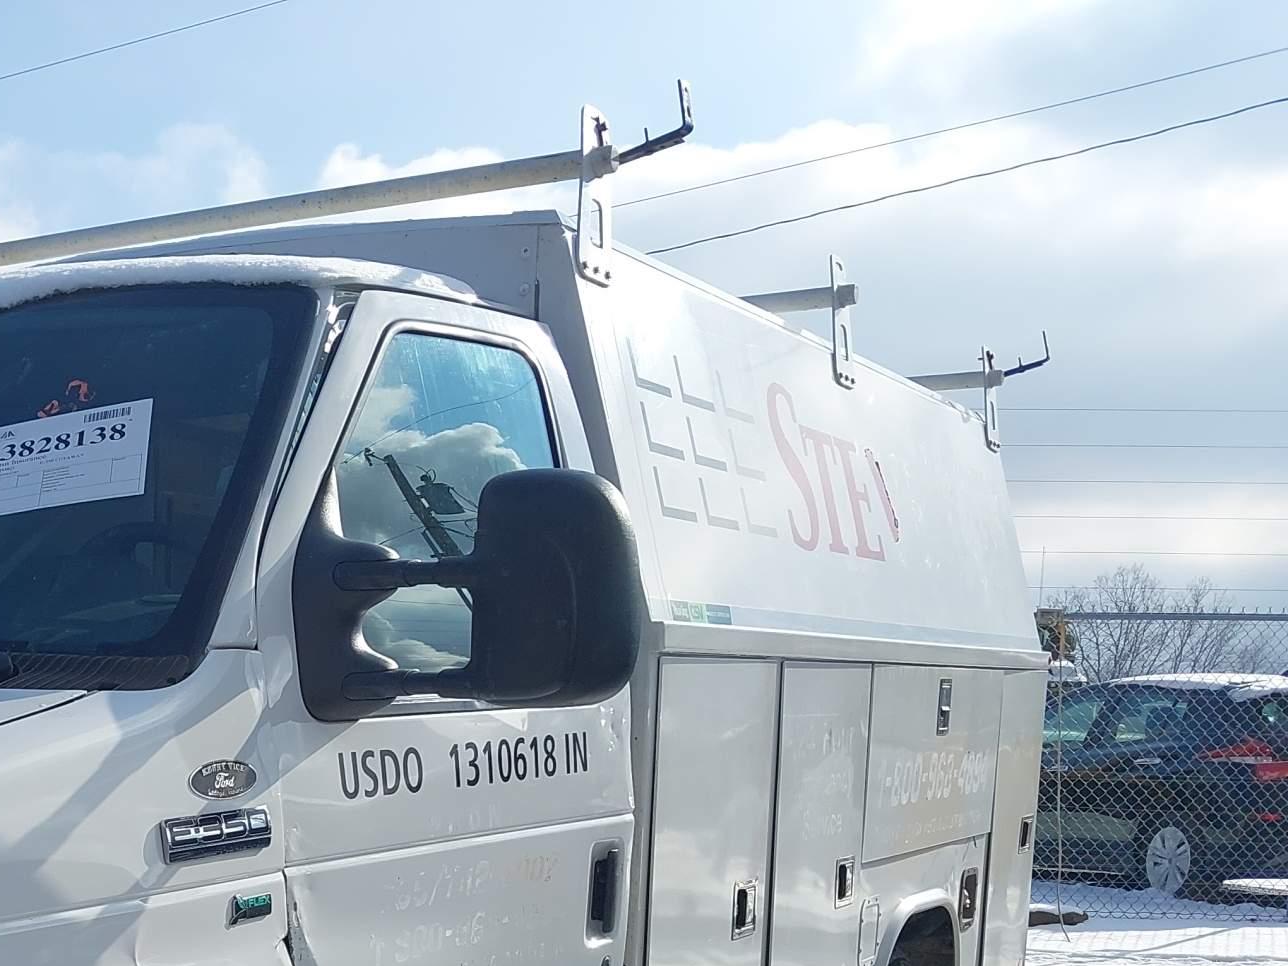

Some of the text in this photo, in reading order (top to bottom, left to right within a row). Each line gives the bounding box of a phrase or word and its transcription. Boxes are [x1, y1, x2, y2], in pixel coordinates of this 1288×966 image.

[338, 731, 589, 799] USDO 1310618 IN
[214, 772, 235, 789] Ford
[248, 895, 270, 908] FLEX
